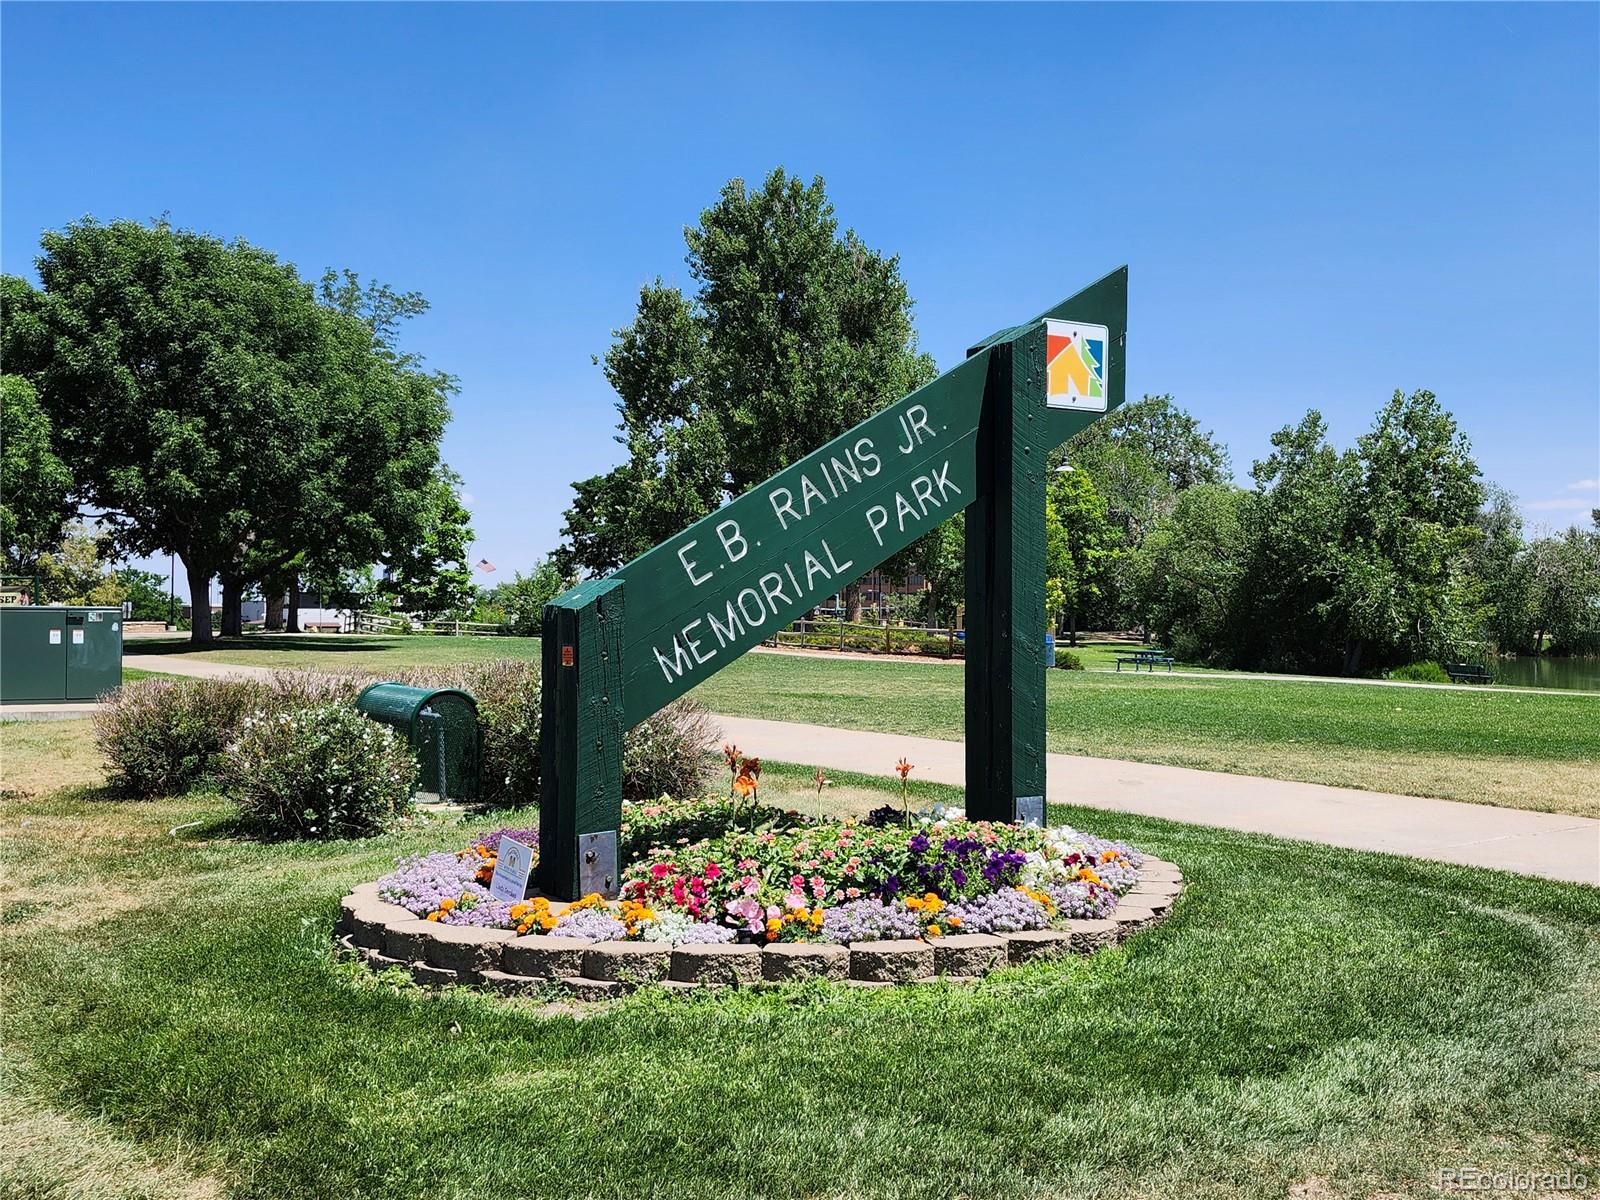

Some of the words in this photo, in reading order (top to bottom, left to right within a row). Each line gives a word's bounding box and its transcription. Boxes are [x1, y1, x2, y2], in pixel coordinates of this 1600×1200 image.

[768, 438, 882, 530] RAINS
[898, 404, 948, 454] JR.
[652, 539, 853, 684] MEMORIAL
[865, 460, 961, 546] PARK
